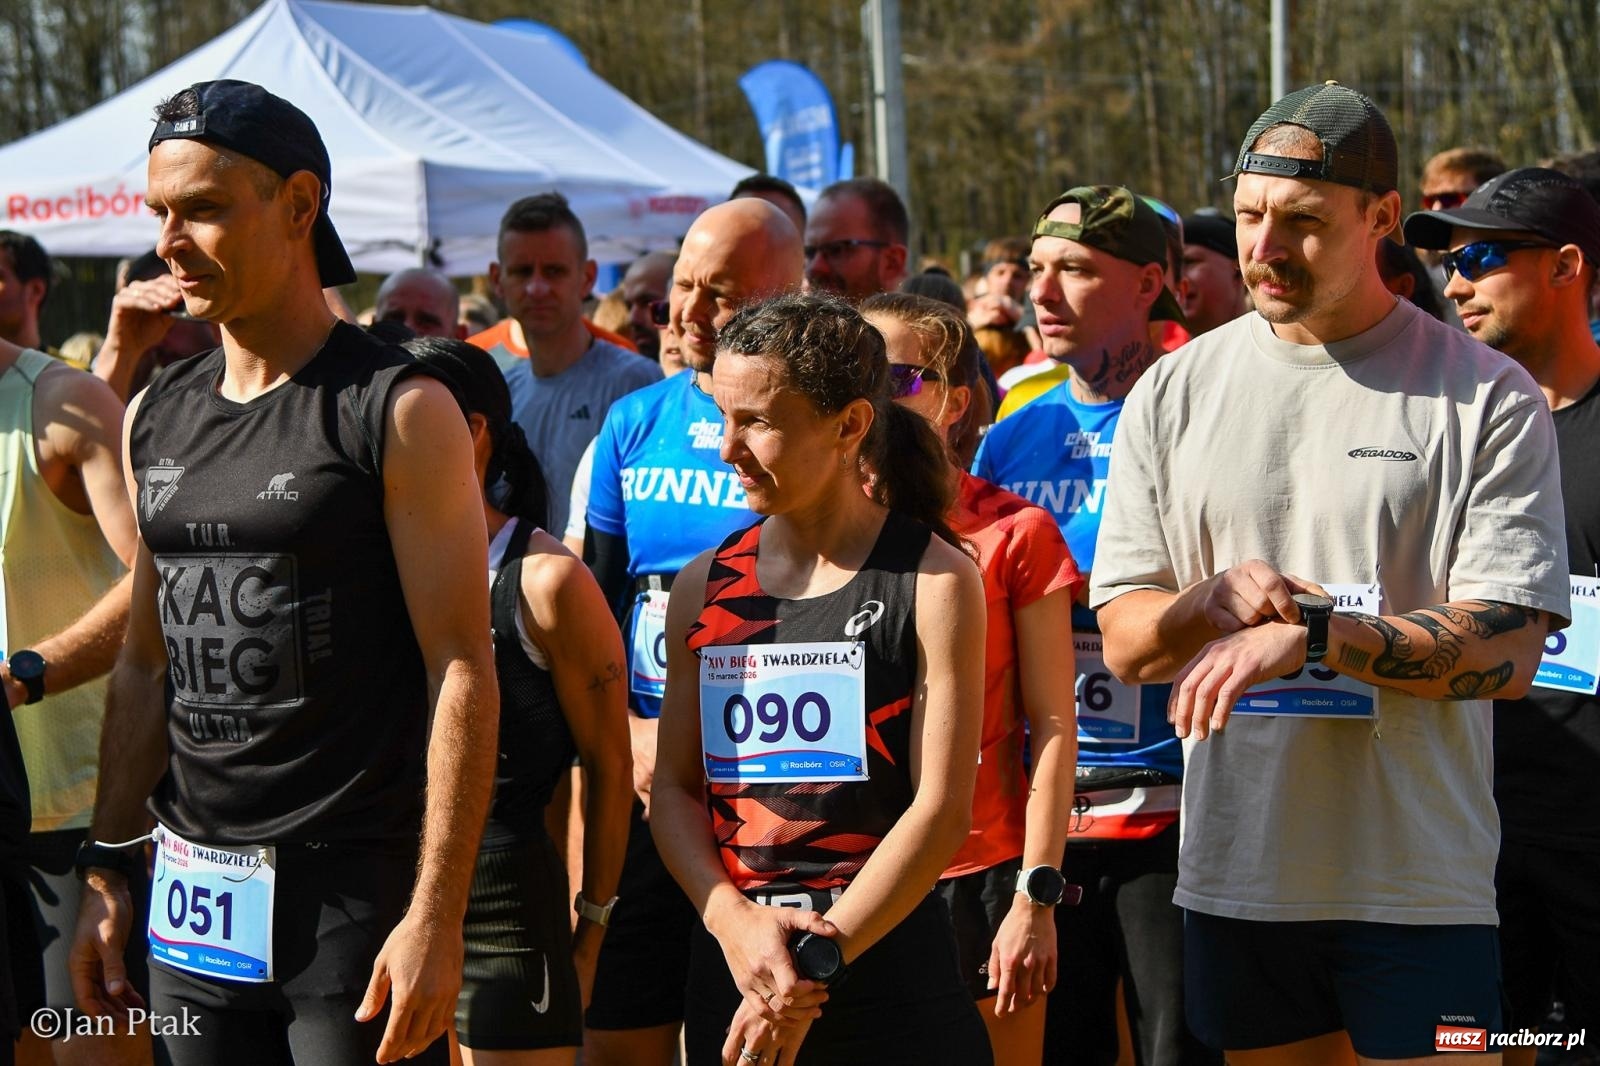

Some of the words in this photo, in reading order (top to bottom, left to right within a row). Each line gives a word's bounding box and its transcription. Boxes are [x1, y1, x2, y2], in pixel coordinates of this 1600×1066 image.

[7, 182, 156, 221] Racibór
[1350, 449, 1413, 460] PEGADOR
[256, 490, 299, 501] ATTIQ
[185, 522, 236, 547] T.U.R.
[162, 566, 277, 629] KAC
[166, 637, 281, 695] BIEG
[708, 655, 727, 669] XIV
[730, 655, 757, 668] BIEG
[762, 652, 850, 667] TWARDZIELA
[707, 673, 715, 681] 15
[716, 673, 739, 681] marzec
[739, 671, 757, 680] 2026
[189, 712, 253, 743] ULTRA
[723, 691, 832, 744] 090
[790, 761, 823, 770] Racibórz
[167, 879, 233, 941] 051
